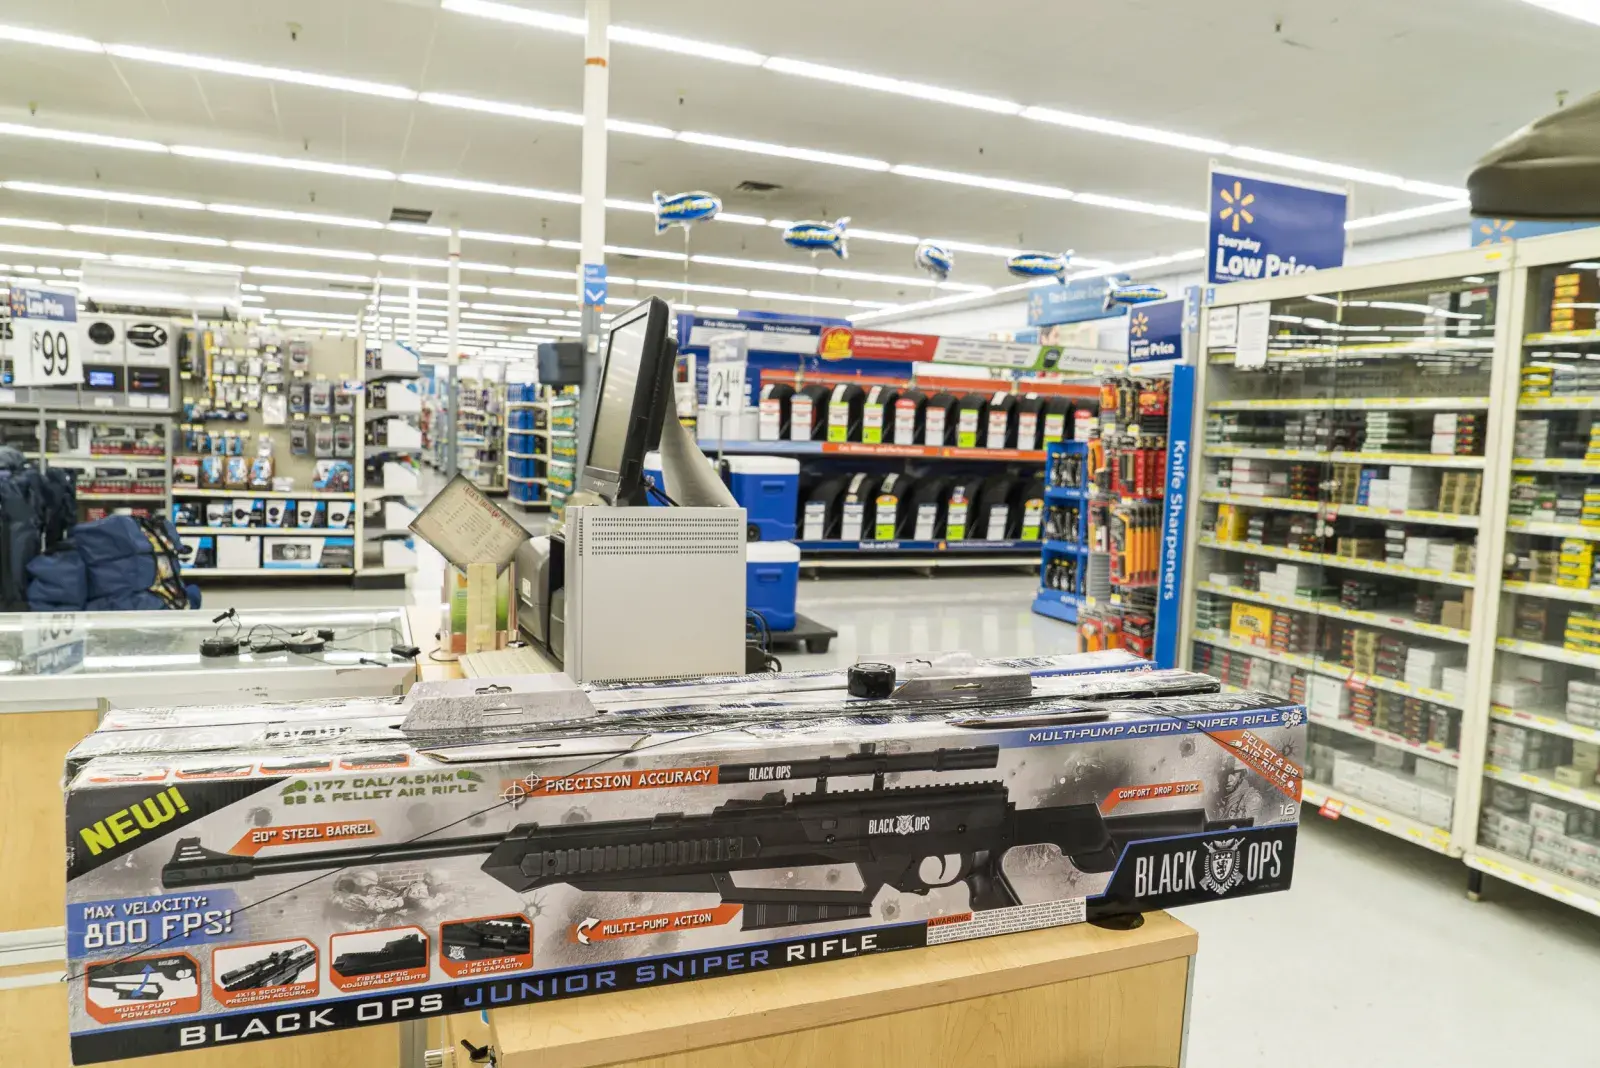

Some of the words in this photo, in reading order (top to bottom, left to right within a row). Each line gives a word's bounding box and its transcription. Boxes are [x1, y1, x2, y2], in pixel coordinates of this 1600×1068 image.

[1217, 233, 1261, 254] Everyday
[1216, 247, 1263, 278] Low
[1131, 344, 1150, 358] Low
[1150, 341, 1176, 356] Price
[1170, 440, 1187, 490] Knife
[1163, 493, 1183, 601] Sharpeners
[1028, 726, 1124, 743] MULTI-PUMP
[1128, 721, 1182, 737] ACTION
[1187, 716, 1238, 730] SNIPER
[1242, 713, 1279, 724] RIFLE
[1241, 730, 1277, 760] PELLET
[1275, 758, 1284, 768] &
[749, 767, 774, 780] BLACK
[775, 765, 791, 779] OPS
[1241, 744, 1261, 761] AIR
[1261, 758, 1289, 783] RIFLE
[308, 779, 346, 792] .177
[352, 773, 454, 789] CAL/4.5MM
[545, 774, 632, 792] PRECISION
[638, 769, 711, 786] ACCURACY
[313, 794, 326, 803] &
[332, 789, 393, 802] PELLET
[397, 786, 426, 798] AIR
[431, 783, 478, 795] RIFLE
[1118, 788, 1151, 799] COMFORT
[1153, 785, 1173, 796] DROP
[1175, 782, 1199, 793] STOCK
[1279, 803, 1296, 816] 16
[79, 786, 190, 856] NEW!
[868, 818, 895, 834] BLACK
[914, 815, 931, 832] OPS
[282, 827, 322, 841] STEEL
[326, 823, 373, 836] BARREL
[1134, 850, 1197, 897] BLACK
[1246, 840, 1283, 882] OPS
[84, 904, 114, 920] MAX
[123, 895, 208, 915] VELOCITY:
[84, 918, 148, 948] 800
[162, 909, 233, 940] FPS!
[603, 917, 669, 935] MULTI-PUMP
[674, 911, 713, 926] ACTION
[471, 959, 502, 968] PELLET
[483, 962, 523, 973] CAPACITY
[340, 978, 394, 989] ADJUSTABLE
[396, 973, 427, 982] SIGHTS
[356, 974, 382, 982] FIBER
[383, 970, 408, 978] OPTIC
[180, 1007, 335, 1047] BLACK
[357, 993, 444, 1022] OPS
[463, 971, 617, 1008] JUNIOR
[636, 949, 770, 985] SNIPER
[786, 933, 878, 963] RIFLE
[225, 994, 271, 1005] PRECISION
[272, 989, 317, 999] ACCURACY
[258, 987, 289, 996] SCOPE
[290, 984, 307, 992] FOR
[113, 1000, 177, 1014] MULTI-PUMP
[120, 1007, 171, 1019] POWERED
